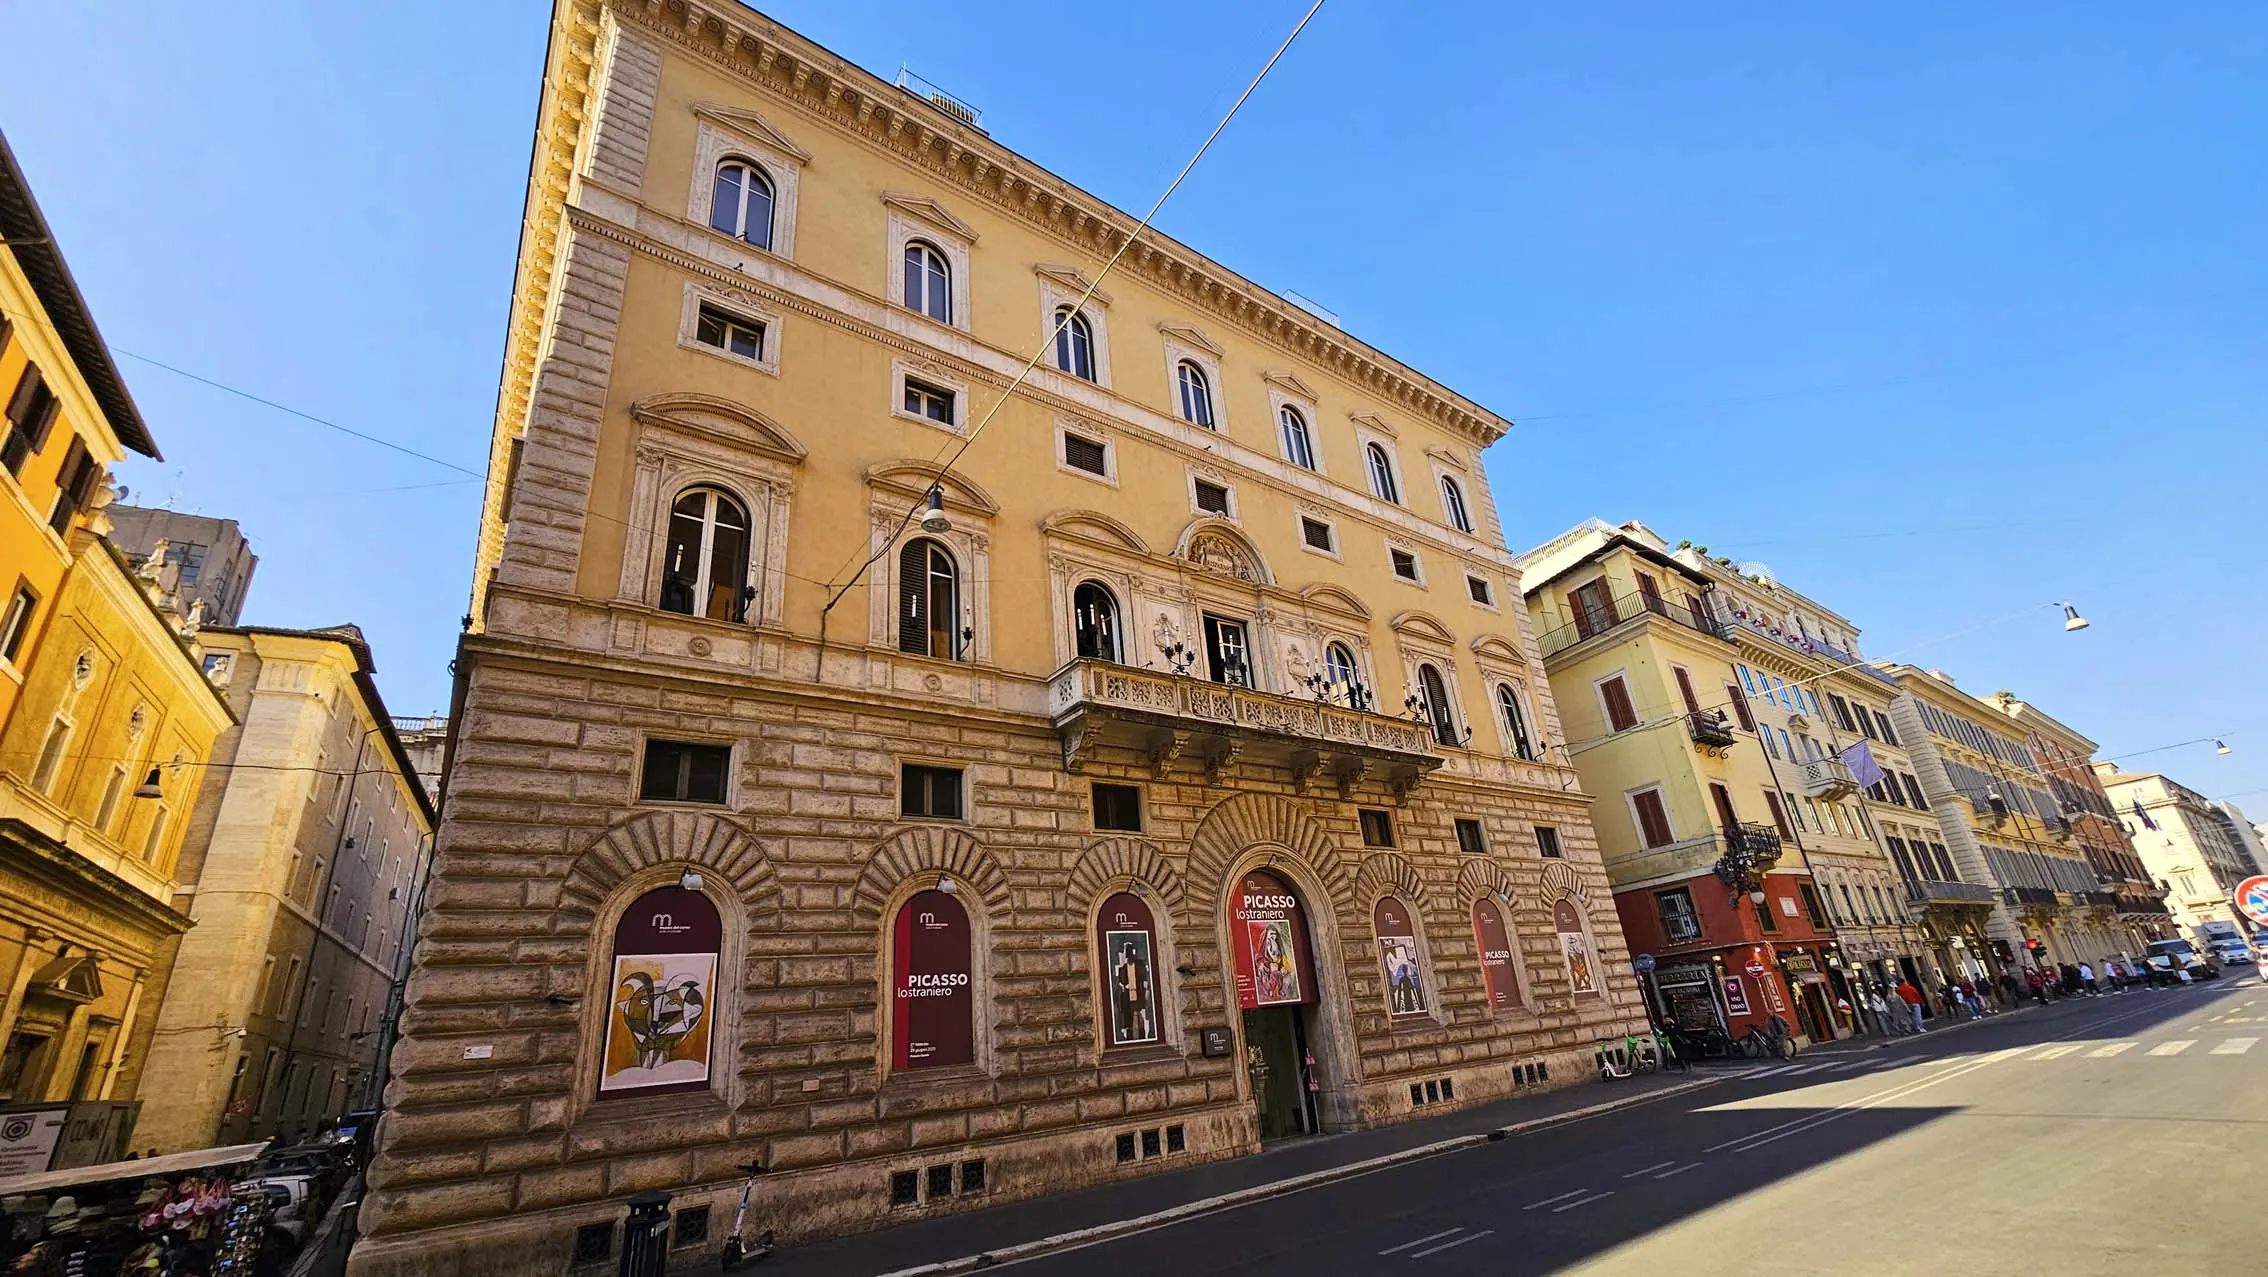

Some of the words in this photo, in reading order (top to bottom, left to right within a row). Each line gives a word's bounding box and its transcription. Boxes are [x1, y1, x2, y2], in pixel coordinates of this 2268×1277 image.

[1243, 895, 1295, 909] PICASSO
[1485, 950, 1510, 960] PICASSO
[908, 973, 968, 987] PICASSO
